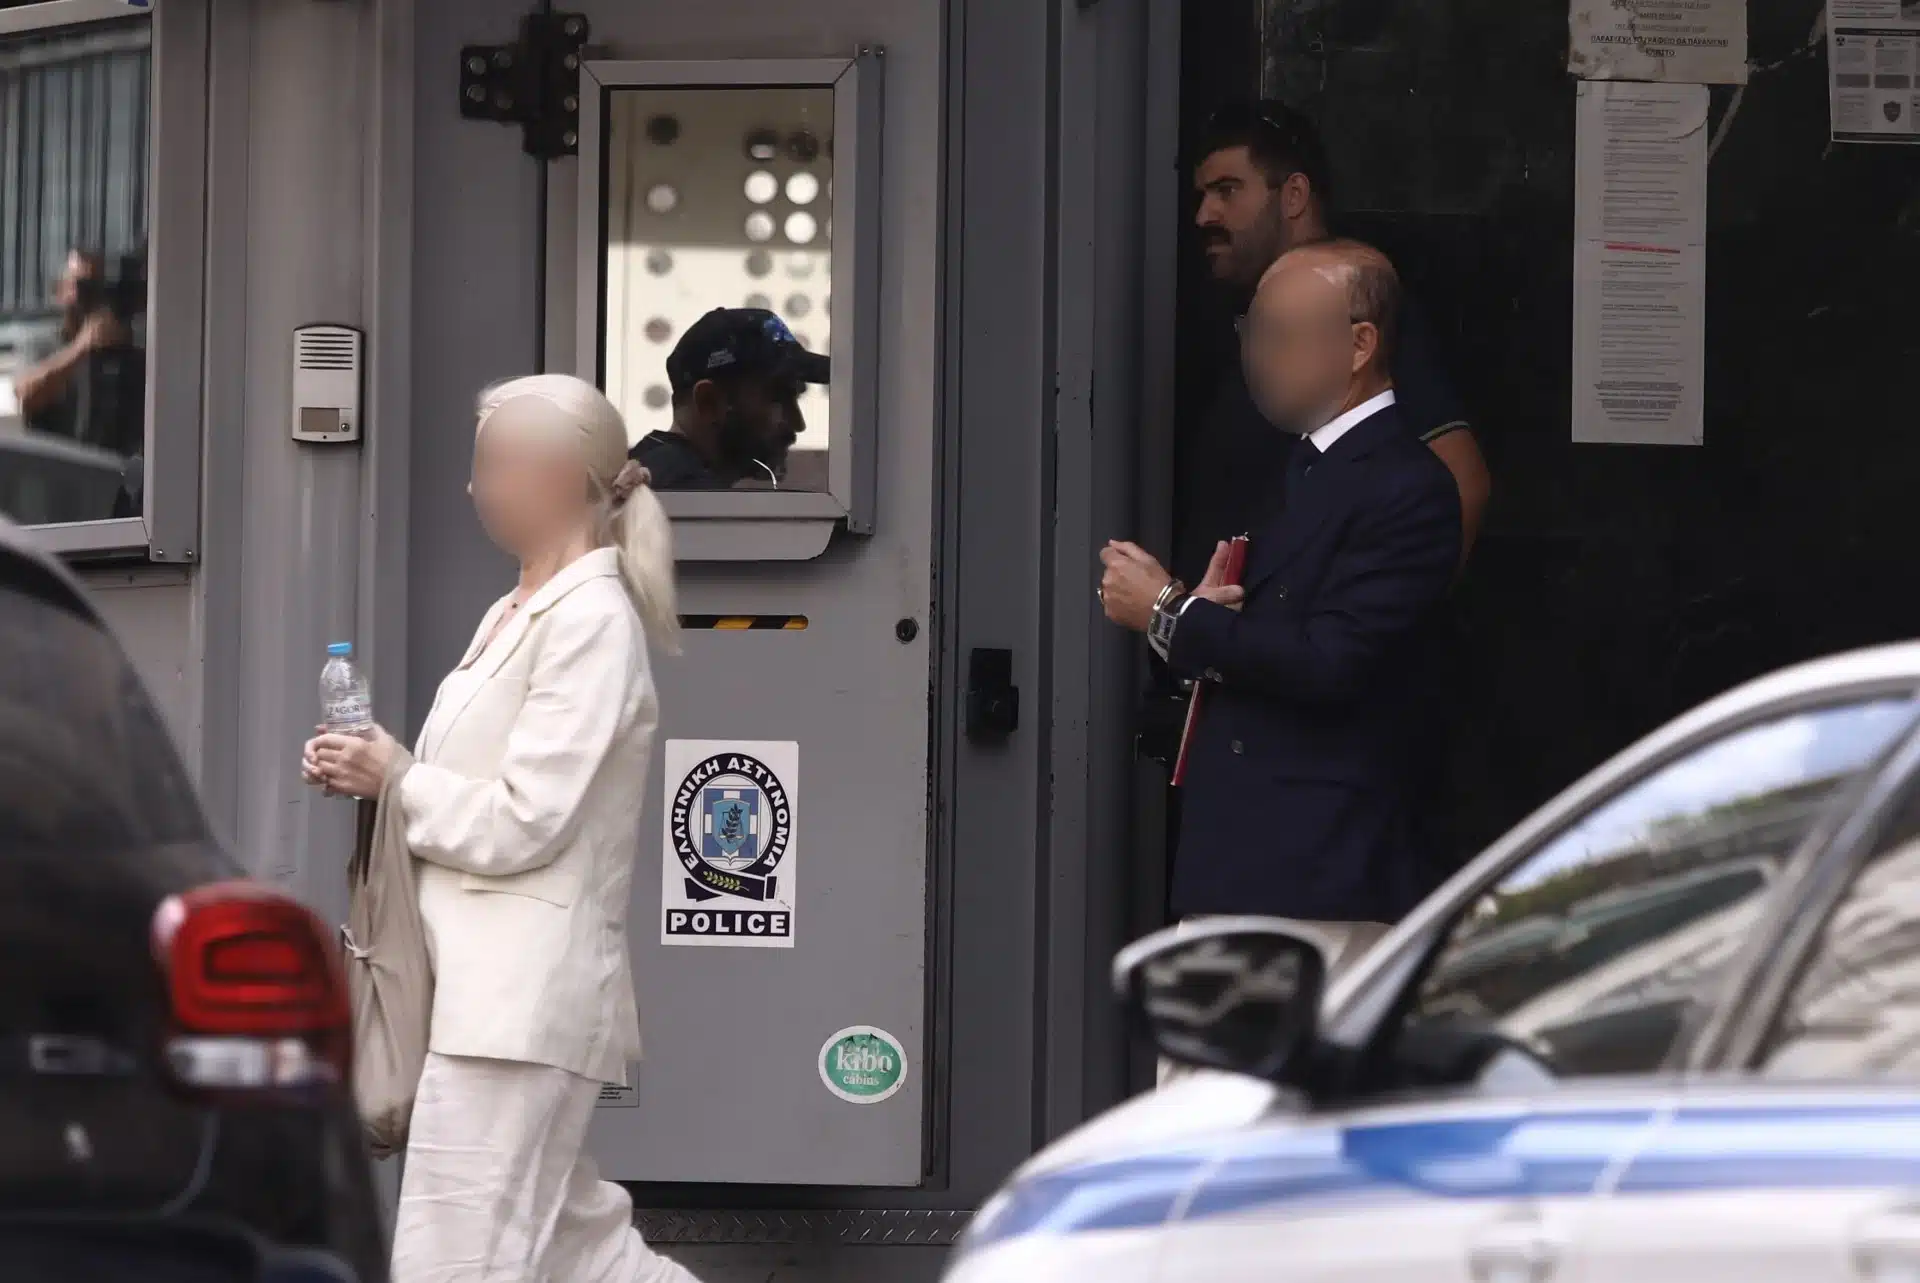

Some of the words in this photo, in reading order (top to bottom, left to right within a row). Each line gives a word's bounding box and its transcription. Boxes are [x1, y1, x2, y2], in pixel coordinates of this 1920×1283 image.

[673, 758, 721, 871] ΕΛΛΗΝΙΚΗ
[726, 756, 790, 868] ΑΣΤΥΝΟΜΙΑ
[670, 912, 786, 934] POLICE
[835, 1045, 893, 1073] kibo
